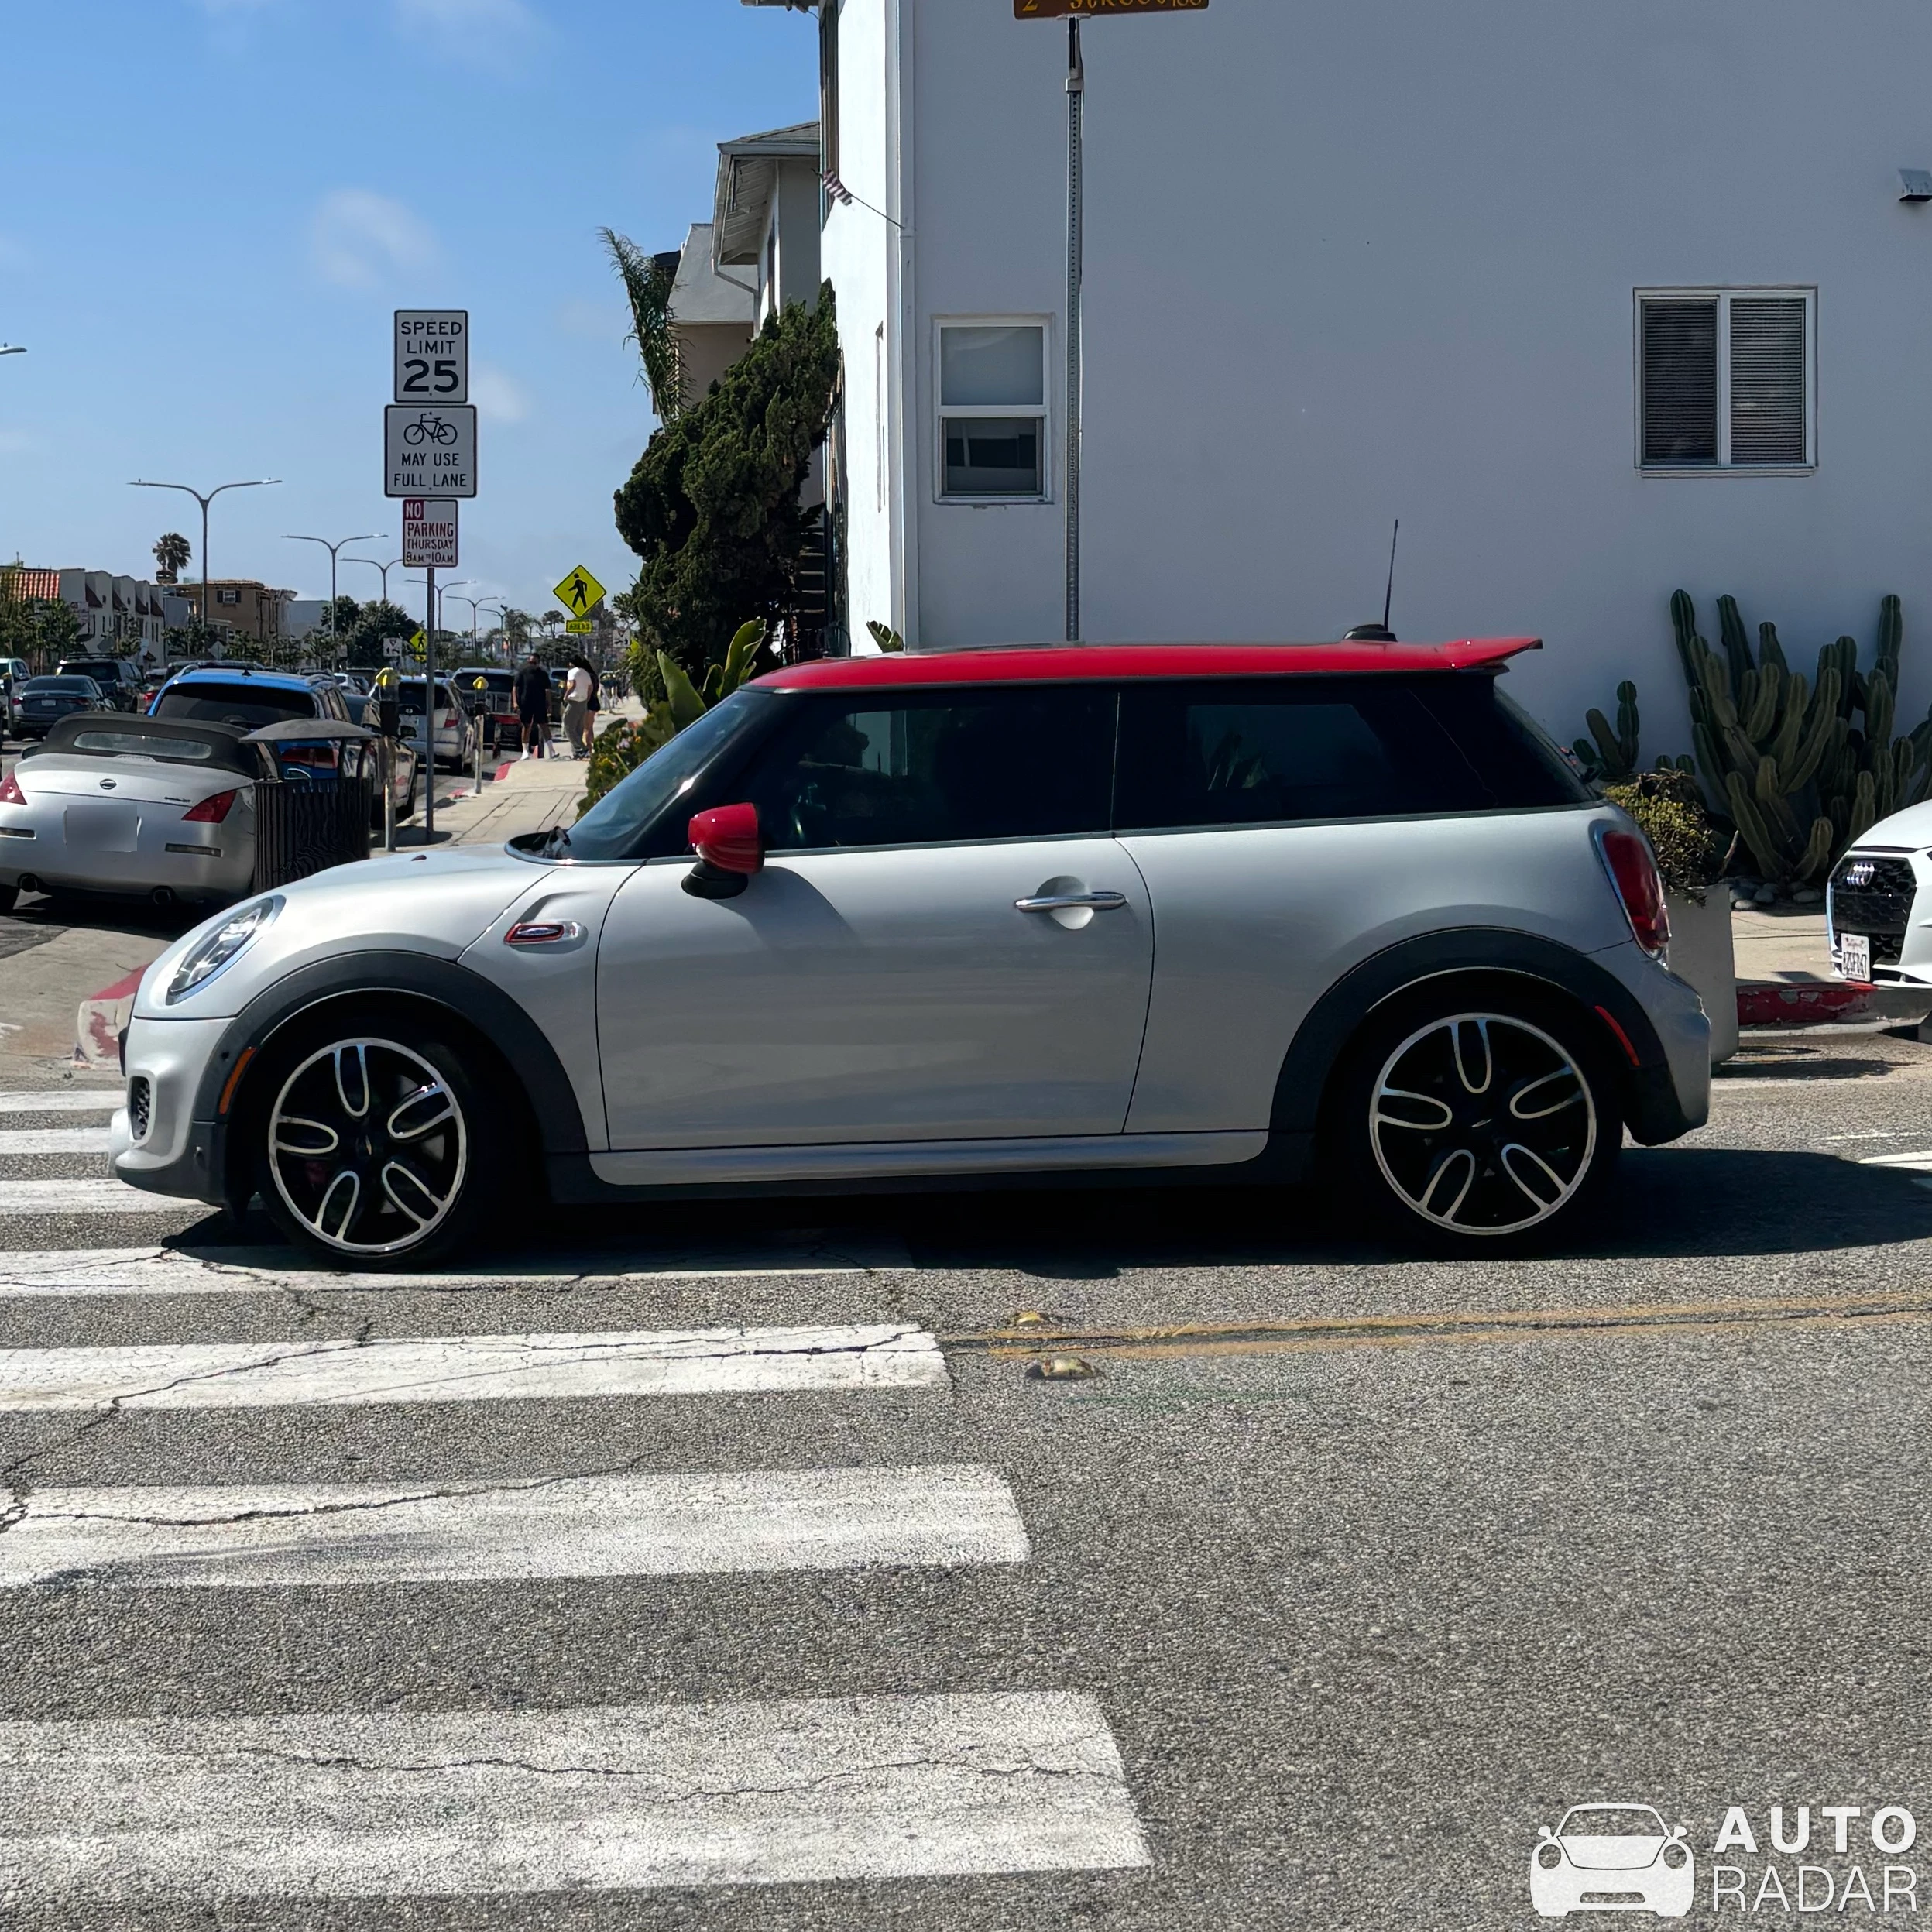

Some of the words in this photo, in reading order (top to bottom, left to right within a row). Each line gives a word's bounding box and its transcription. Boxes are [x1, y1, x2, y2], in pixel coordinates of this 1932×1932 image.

[401, 321, 462, 335] SPEED
[407, 340, 456, 354] LIMIT
[403, 359, 459, 393] 25
[401, 452, 427, 466] MAY
[434, 452, 460, 466] USE
[394, 473, 427, 486] FULL
[433, 473, 467, 487] LANE
[406, 502, 422, 518] NO
[407, 522, 454, 537] PARKING
[407, 539, 454, 550] THURSDAY
[406, 551, 424, 562] 8AM
[431, 552, 454, 563] 10AM
